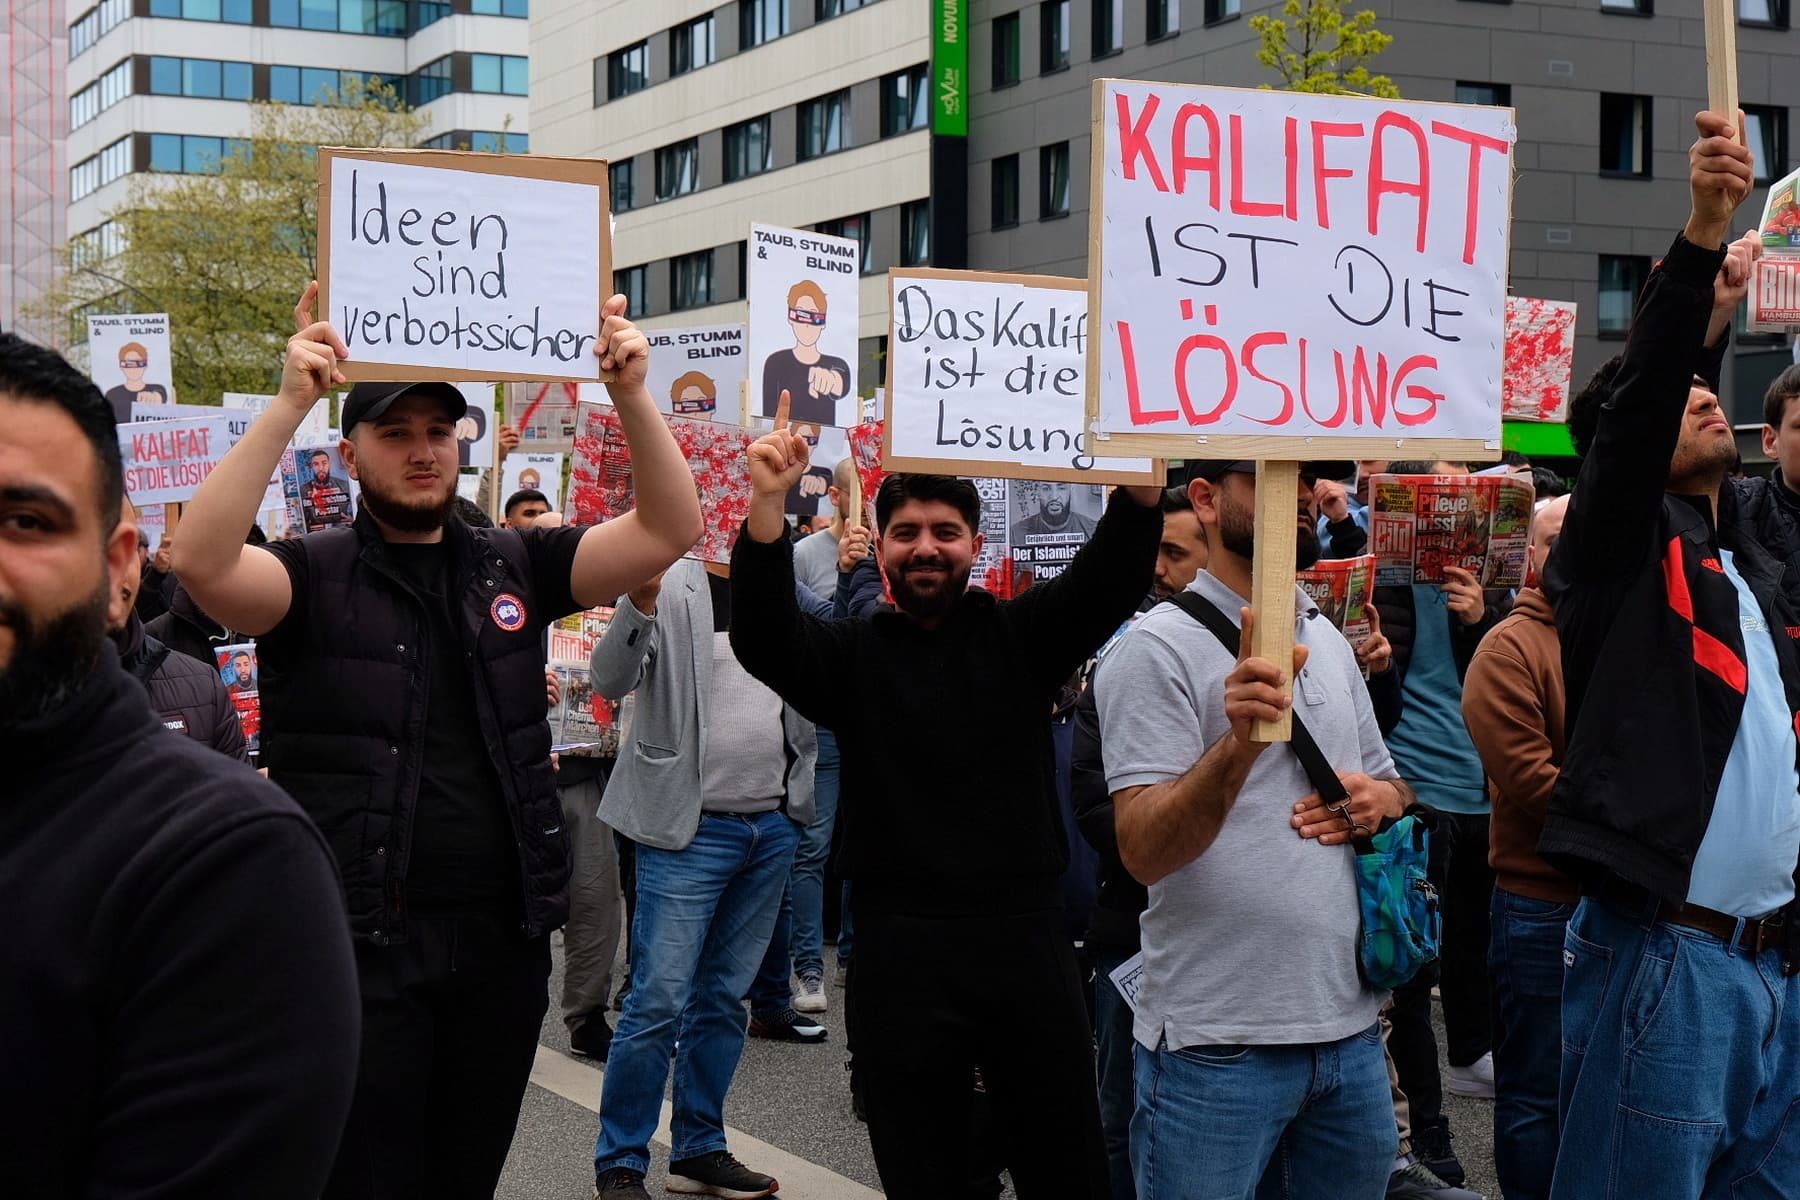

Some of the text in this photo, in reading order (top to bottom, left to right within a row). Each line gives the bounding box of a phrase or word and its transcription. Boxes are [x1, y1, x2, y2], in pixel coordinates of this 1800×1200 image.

[1115, 92, 1509, 265] KALIFAT
[351, 169, 508, 250] Ideen
[754, 230, 854, 258] TAUB, STUMM
[757, 245, 853, 274] & BLIND
[1145, 215, 1470, 342] IST DIE
[1760, 264, 1800, 310] Bil
[94, 327, 164, 336] & BLIND
[343, 297, 597, 362] verbotssicher
[992, 296, 1088, 354] Kalif
[1761, 311, 1800, 319] HAMBUR
[646, 329, 742, 347] UB, STUMM
[687, 345, 742, 359] BLIND
[923, 346, 1080, 396] ist die
[1116, 298, 1446, 429] LÖSUNG
[132, 427, 210, 463] KALIFAT
[936, 399, 1095, 470] Lösung
[146, 466, 169, 490] DIE
[980, 488, 1005, 500] OST
[1013, 547, 1032, 560] Der
